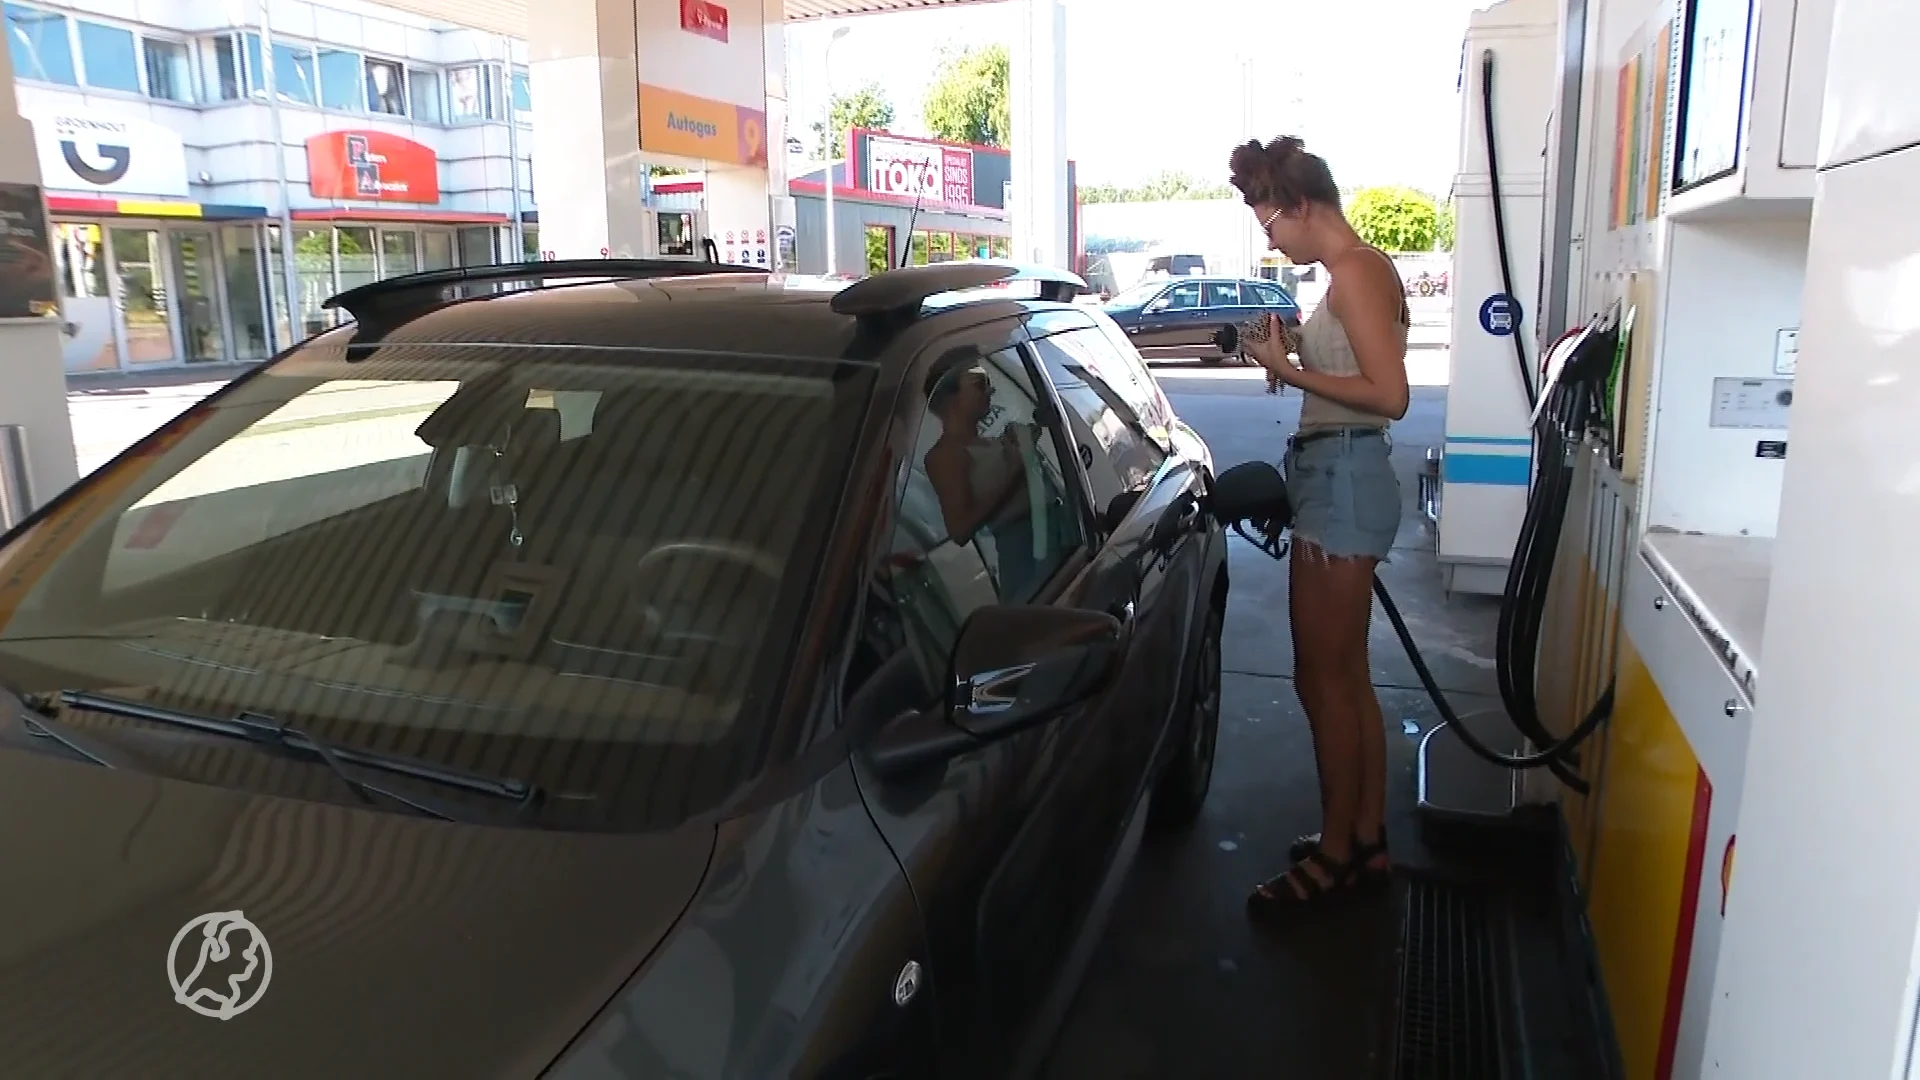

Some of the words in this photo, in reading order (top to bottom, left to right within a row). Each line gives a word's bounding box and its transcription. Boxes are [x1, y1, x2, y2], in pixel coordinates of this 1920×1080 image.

[667, 111, 717, 138] Autogas
[744, 119, 760, 158] 9
[944, 184, 969, 208] 1995
